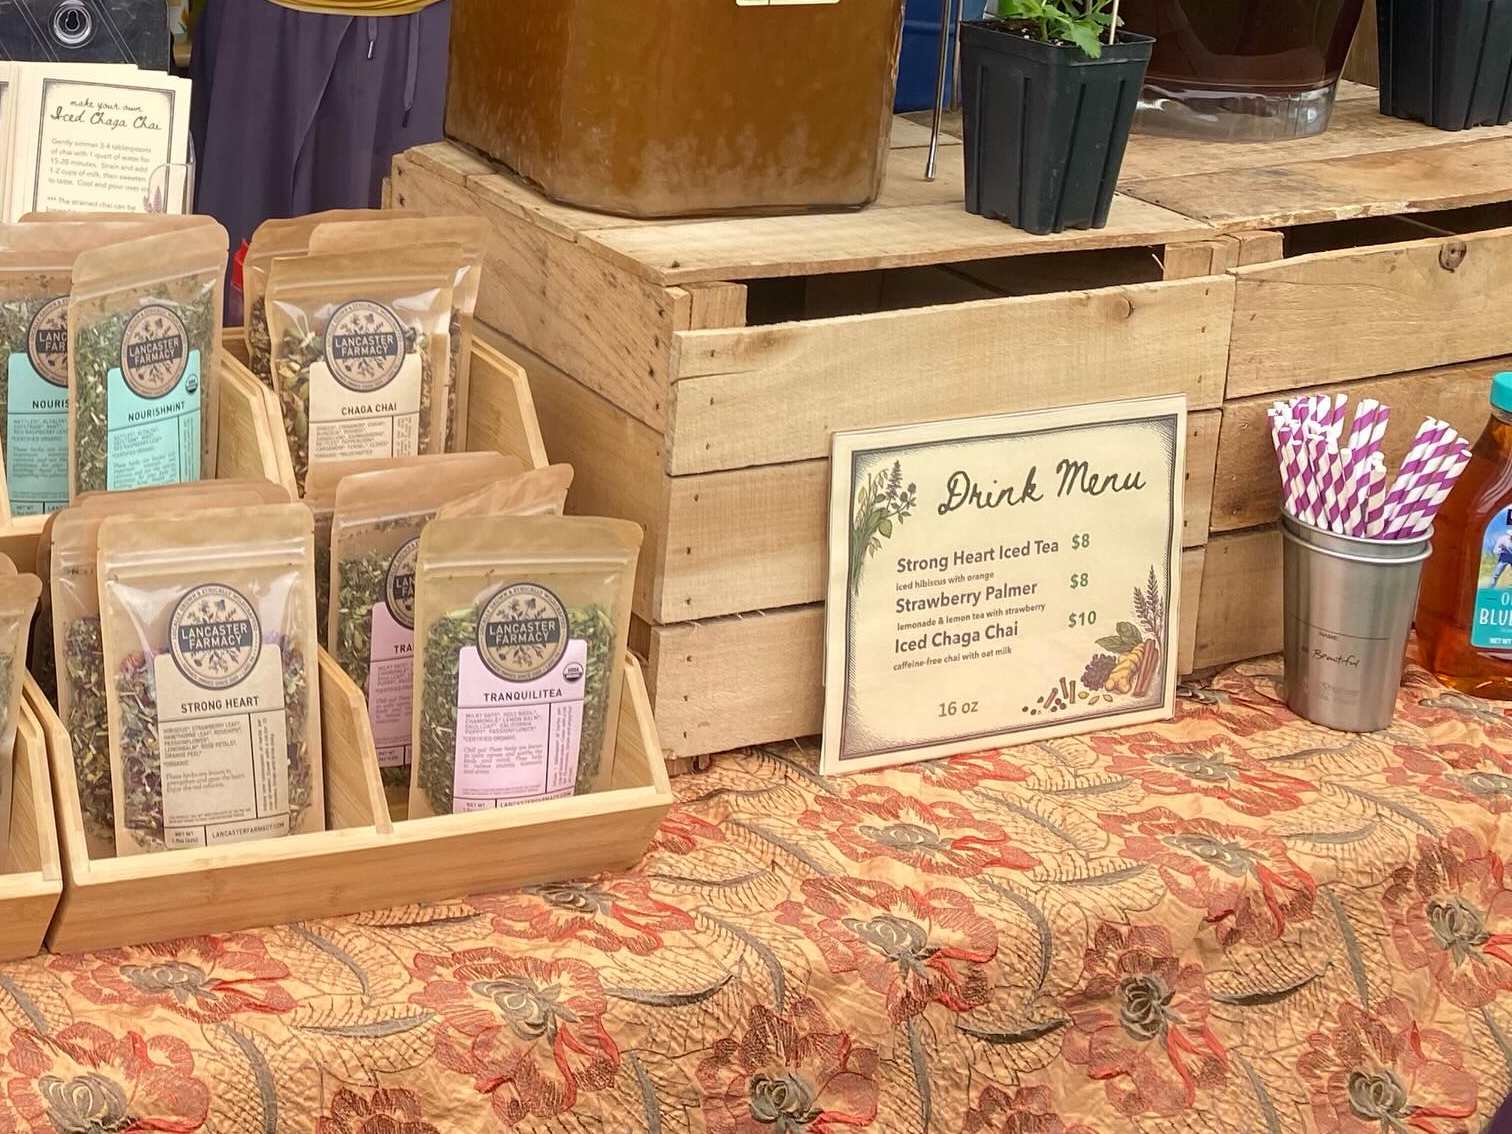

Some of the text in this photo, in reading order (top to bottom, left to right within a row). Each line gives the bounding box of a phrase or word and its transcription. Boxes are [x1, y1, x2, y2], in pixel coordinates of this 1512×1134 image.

[69, 97, 144, 113] make your own
[50, 106, 163, 131] Iced Chaga Chai
[129, 337, 180, 358] LANCASTER
[335, 334, 394, 348] LANCASTER
[134, 348, 176, 365] FARMACY
[341, 344, 389, 357] FARMACY
[128, 401, 186, 422] NOURISHMINT
[341, 402, 397, 416] CHAGA CHAI
[938, 458, 1147, 515] Drink Menu
[897, 533, 1090, 574] Strong Heart Iced Tea $8
[895, 571, 995, 591] iced hibiscus with orange
[895, 572, 1089, 613] Strawberry Palmer $8
[897, 603, 1046, 631] lemonade & lemon tea with strawberry
[181, 622, 248, 640] LANCASTER
[489, 620, 556, 636] LANCASTER
[895, 610, 1097, 654] Iced Chaga Chai $10
[189, 634, 242, 650] FARMACY
[495, 631, 549, 645] FARMACY
[893, 645, 1013, 671] caffeine-free chai with oat milk
[484, 688, 563, 702] TRANQUILITEA
[181, 695, 260, 714] STRONG HEART
[938, 699, 979, 717] 16 oz
